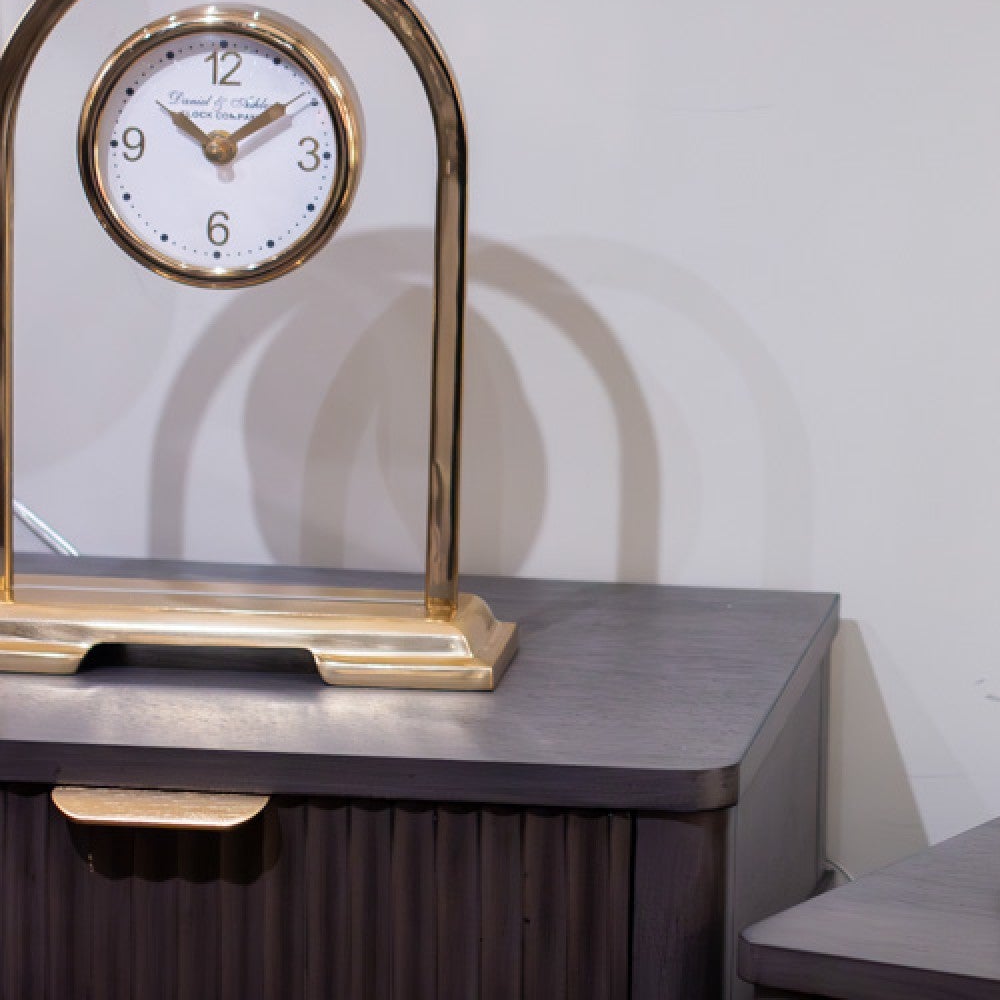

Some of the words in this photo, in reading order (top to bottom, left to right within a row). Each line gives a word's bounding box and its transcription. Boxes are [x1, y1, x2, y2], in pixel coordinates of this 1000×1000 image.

[204, 51, 242, 85] 12
[122, 127, 145, 162] 9
[298, 136, 321, 172] 3
[207, 211, 230, 246] 6
